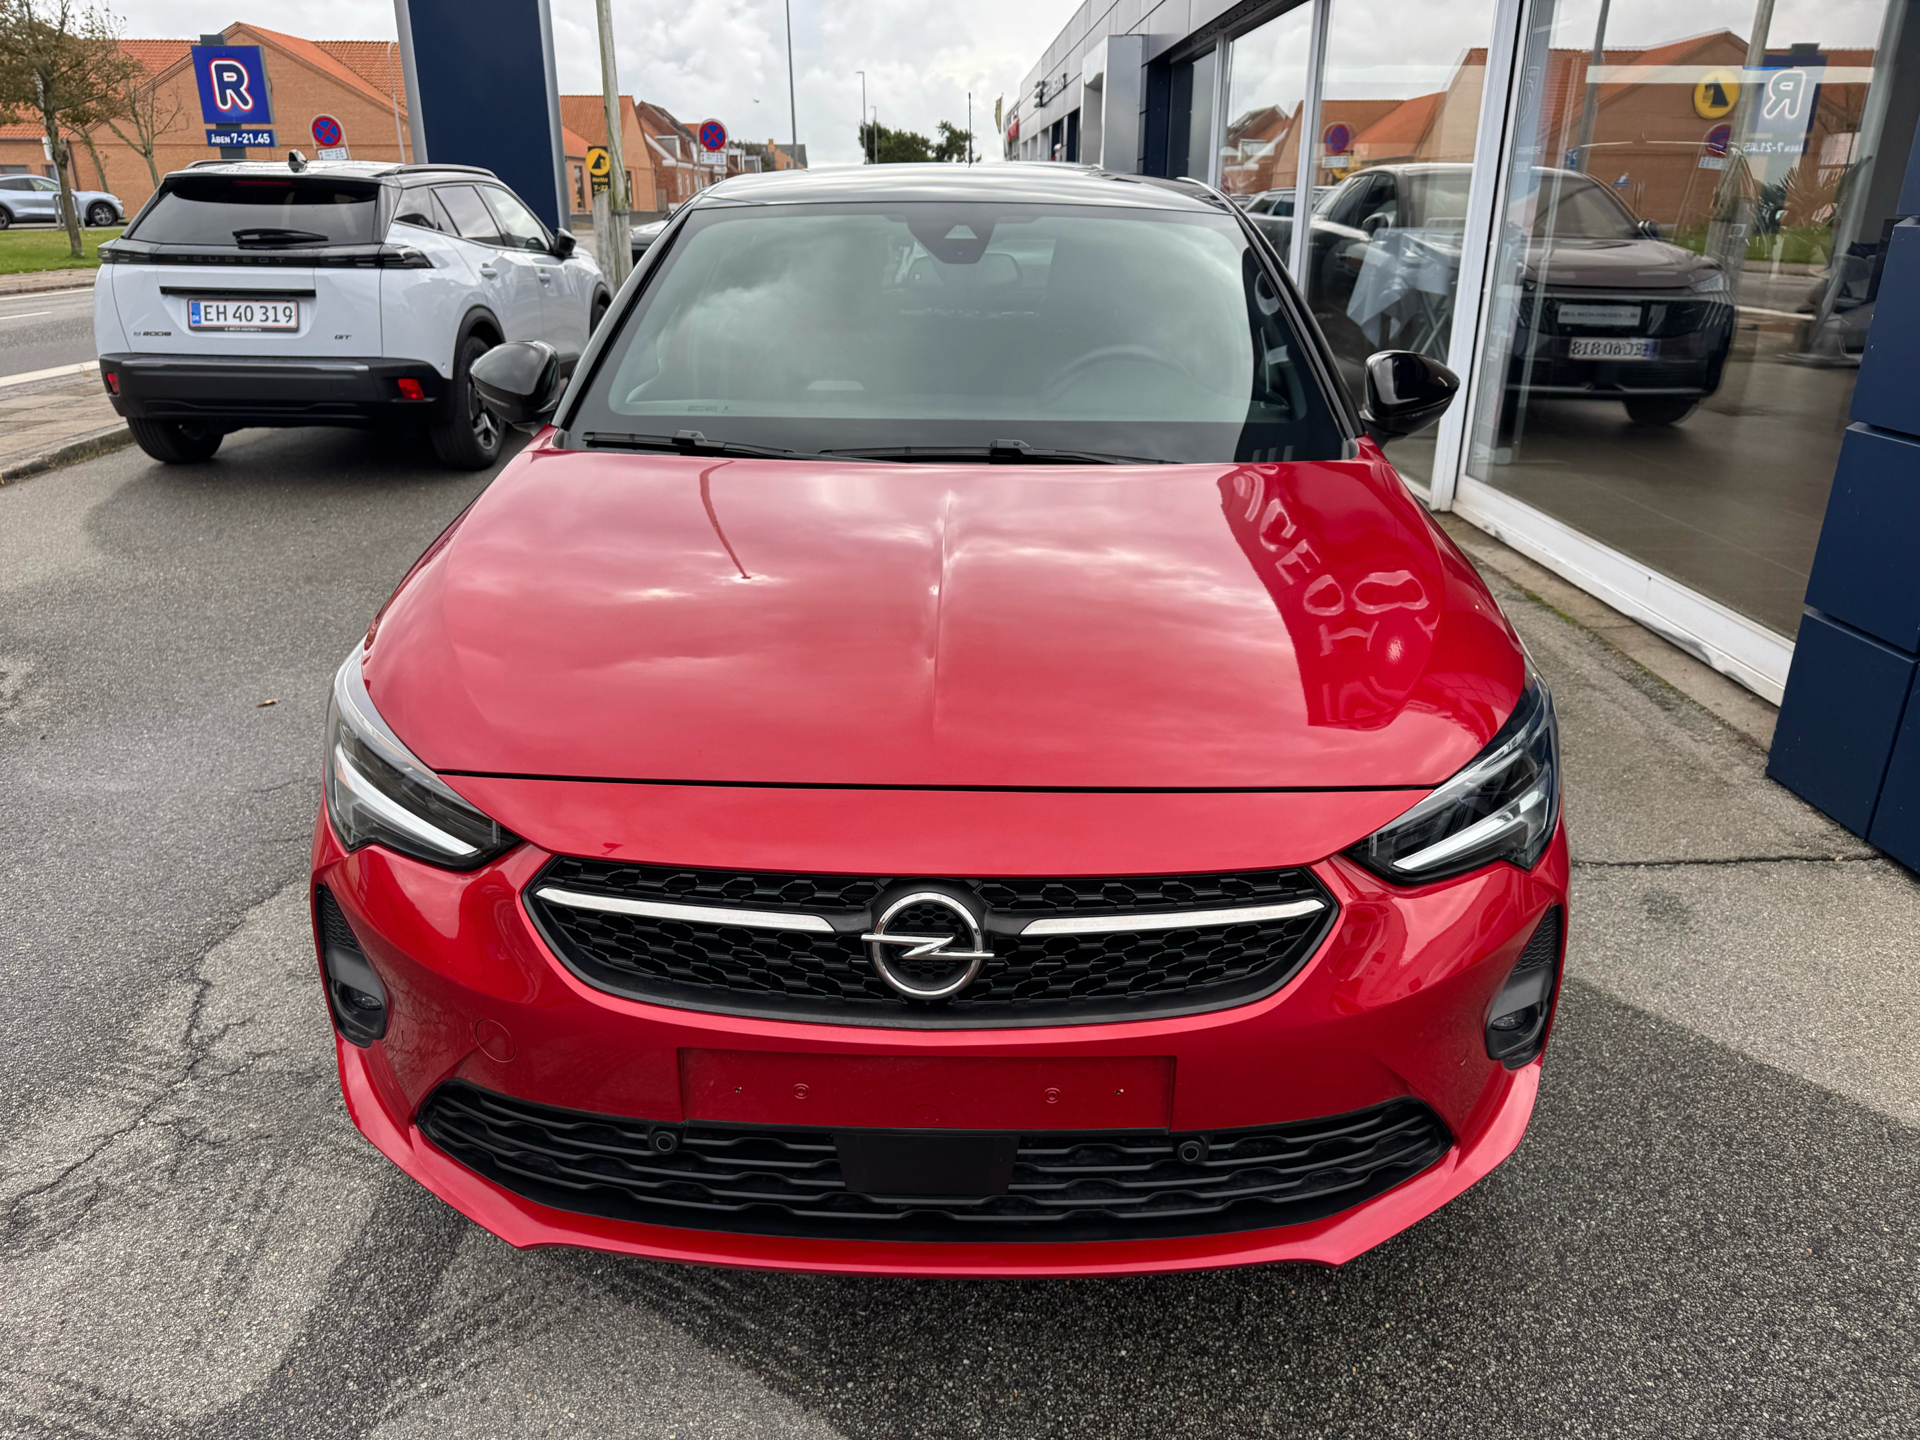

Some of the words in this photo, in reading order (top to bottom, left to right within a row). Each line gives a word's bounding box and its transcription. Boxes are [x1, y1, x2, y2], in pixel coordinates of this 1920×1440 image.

[208, 58, 254, 112] R
[211, 134, 231, 144] ÅBEN
[231, 133, 270, 144] 7-21.45
[177, 255, 285, 263] PEUGEOT
[203, 305, 227, 322] EH
[232, 305, 254, 322] 40
[259, 306, 293, 324] 319
